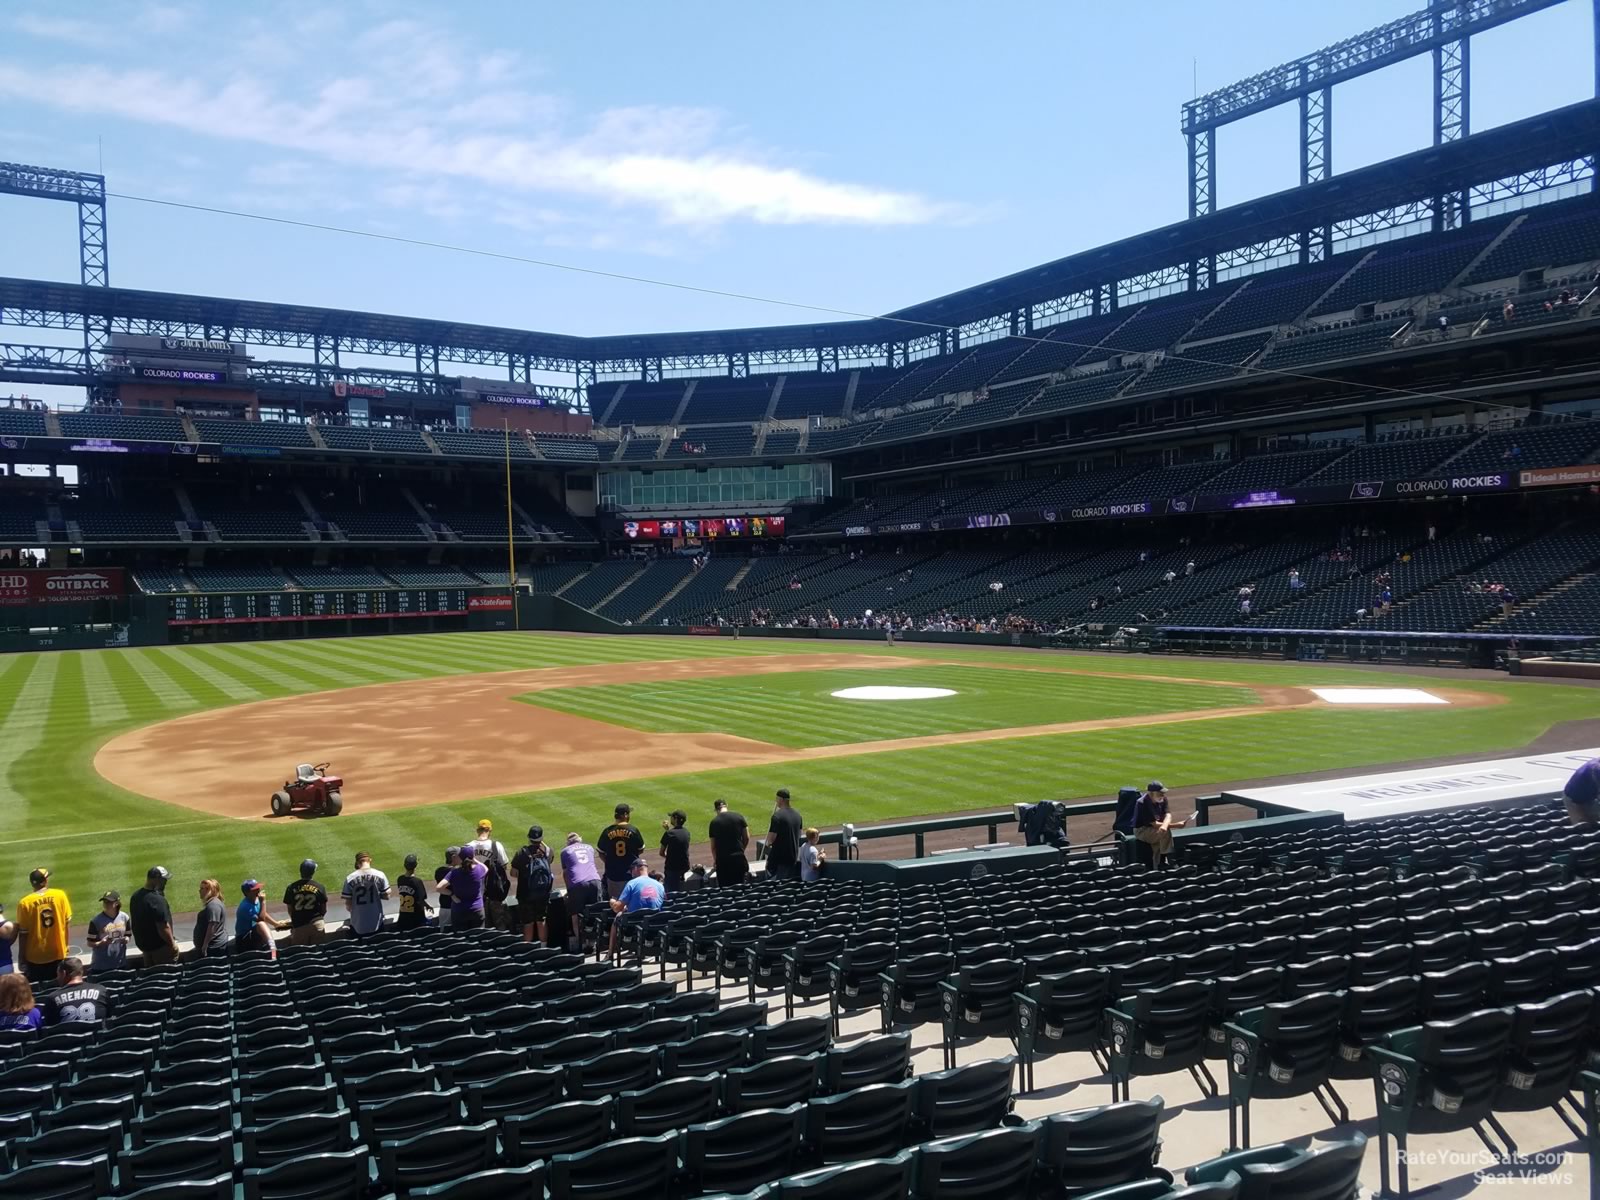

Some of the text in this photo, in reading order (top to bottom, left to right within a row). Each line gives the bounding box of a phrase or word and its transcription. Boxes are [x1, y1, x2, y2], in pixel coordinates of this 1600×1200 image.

[143, 369, 216, 381] COLORADO ROCKIES
[486, 394, 541, 406] COLORADO ROCKIES
[1396, 475, 1502, 493] COLORADO ROCKIES
[1532, 473, 1557, 482] Ideal
[1559, 471, 1590, 480] Home
[1071, 506, 1108, 518] COLORADO
[1110, 503, 1146, 515] ROCKIES
[900, 522, 921, 531] ROCKIES
[46, 580, 109, 590] OUTBACK
[1342, 773, 1524, 800] WELCOME TO
[616, 840, 626, 857] 8
[294, 893, 317, 911] 22
[355, 886, 375, 905] 21
[41, 909, 55, 928] 6
[54, 988, 100, 1006] ARENADO
